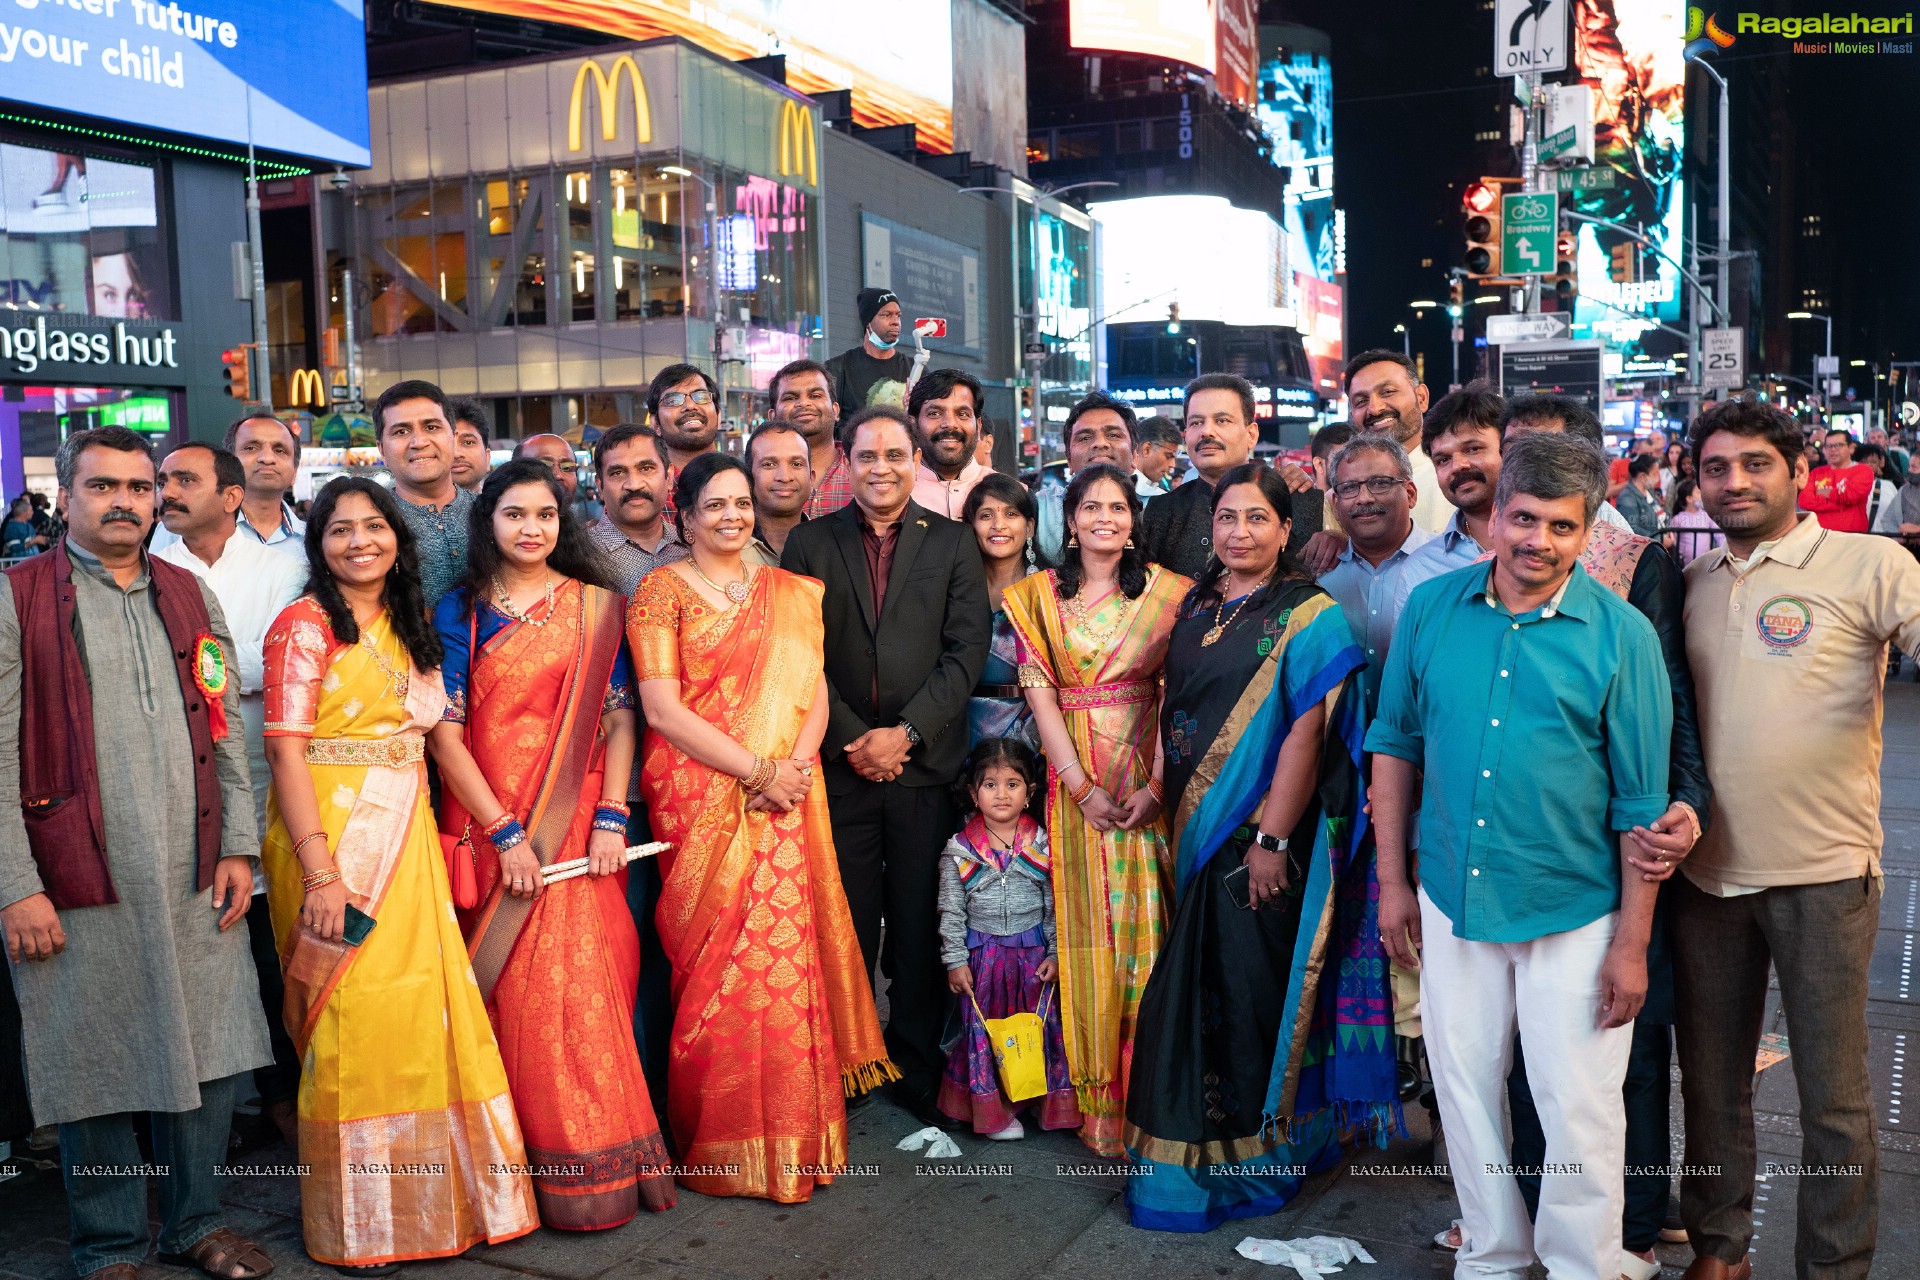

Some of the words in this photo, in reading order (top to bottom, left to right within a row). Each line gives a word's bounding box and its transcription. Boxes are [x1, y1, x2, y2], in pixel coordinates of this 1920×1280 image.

[131, 0, 238, 48] future
[0, 22, 89, 67] your
[101, 38, 184, 89] child
[1507, 47, 1554, 67] ONLY
[1560, 172, 1573, 189] W
[1580, 171, 1597, 188] 45
[1506, 224, 1551, 234] Broadway
[1501, 325, 1521, 335] ONE
[1534, 321, 1558, 332] WAY
[114, 322, 178, 368] hut
[1709, 353, 1737, 369] 25
[1764, 613, 1803, 629] TANA
